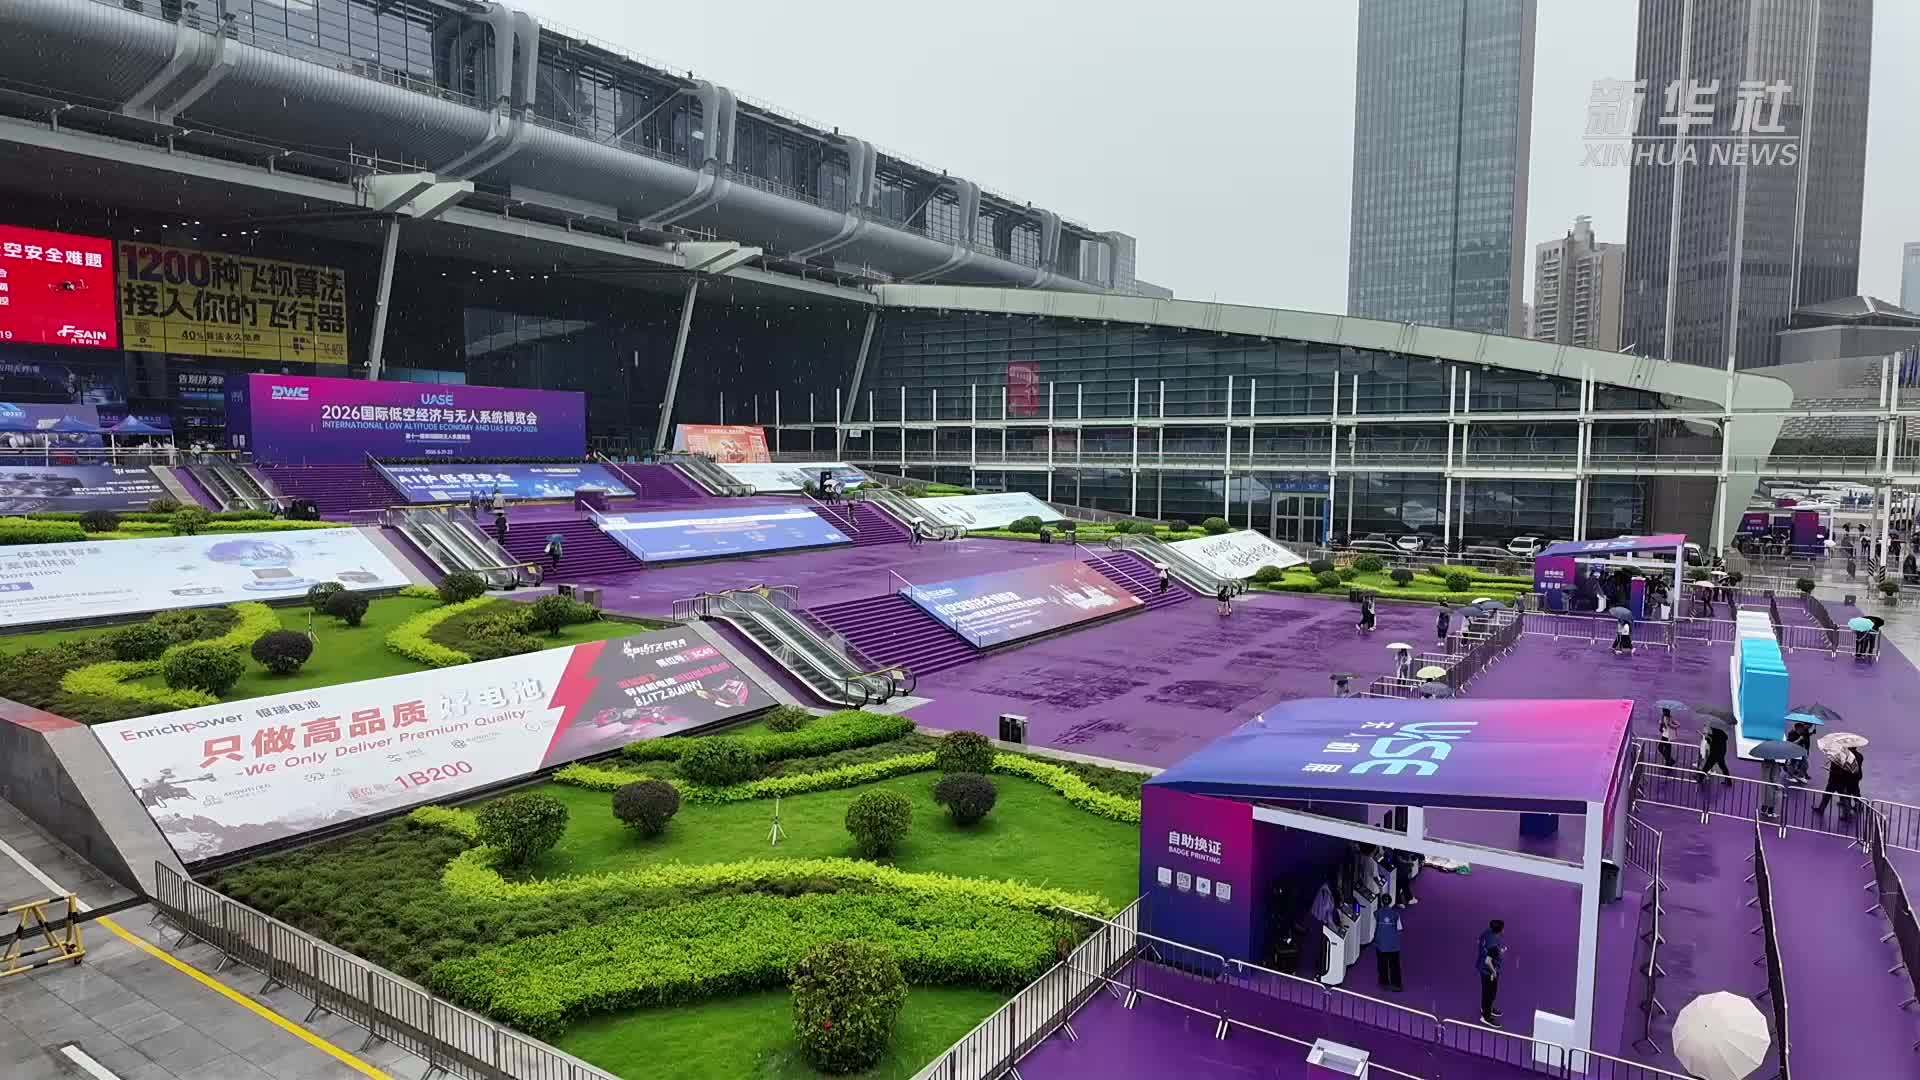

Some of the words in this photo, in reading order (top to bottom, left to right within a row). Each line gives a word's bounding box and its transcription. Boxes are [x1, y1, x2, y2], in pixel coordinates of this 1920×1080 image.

[0, 242, 102, 268] 空安全难题
[121, 244, 344, 303] 1200种飞视算法
[124, 282, 345, 333] 接入你的飞行器
[57, 325, 107, 341] FSAIN
[272, 386, 309, 397] DWC
[421, 393, 454, 406] UASE
[321, 405, 538, 425] 2026国际低空经济与无人系统博览会
[322, 421, 384, 430] INTERNATIONAL
[385, 422, 402, 430] LOW
[404, 423, 438, 431] ALTITUDE
[439, 423, 473, 431] ECONOMY
[490, 424, 504, 432] UAS
[120, 712, 243, 742] Enrichpower
[200, 699, 428, 768] 只做高品质
[440, 677, 545, 719] 好电池
[285, 752, 328, 768] Only
[335, 736, 393, 758] Deliver
[400, 722, 469, 743] Premium
[1349, 721, 1479, 776] UASE
[395, 760, 473, 791] 1B200
[1168, 846, 1190, 857] BADGE
[1190, 851, 1221, 865] PRINTING
[1169, 831, 1222, 856] 自助换证
